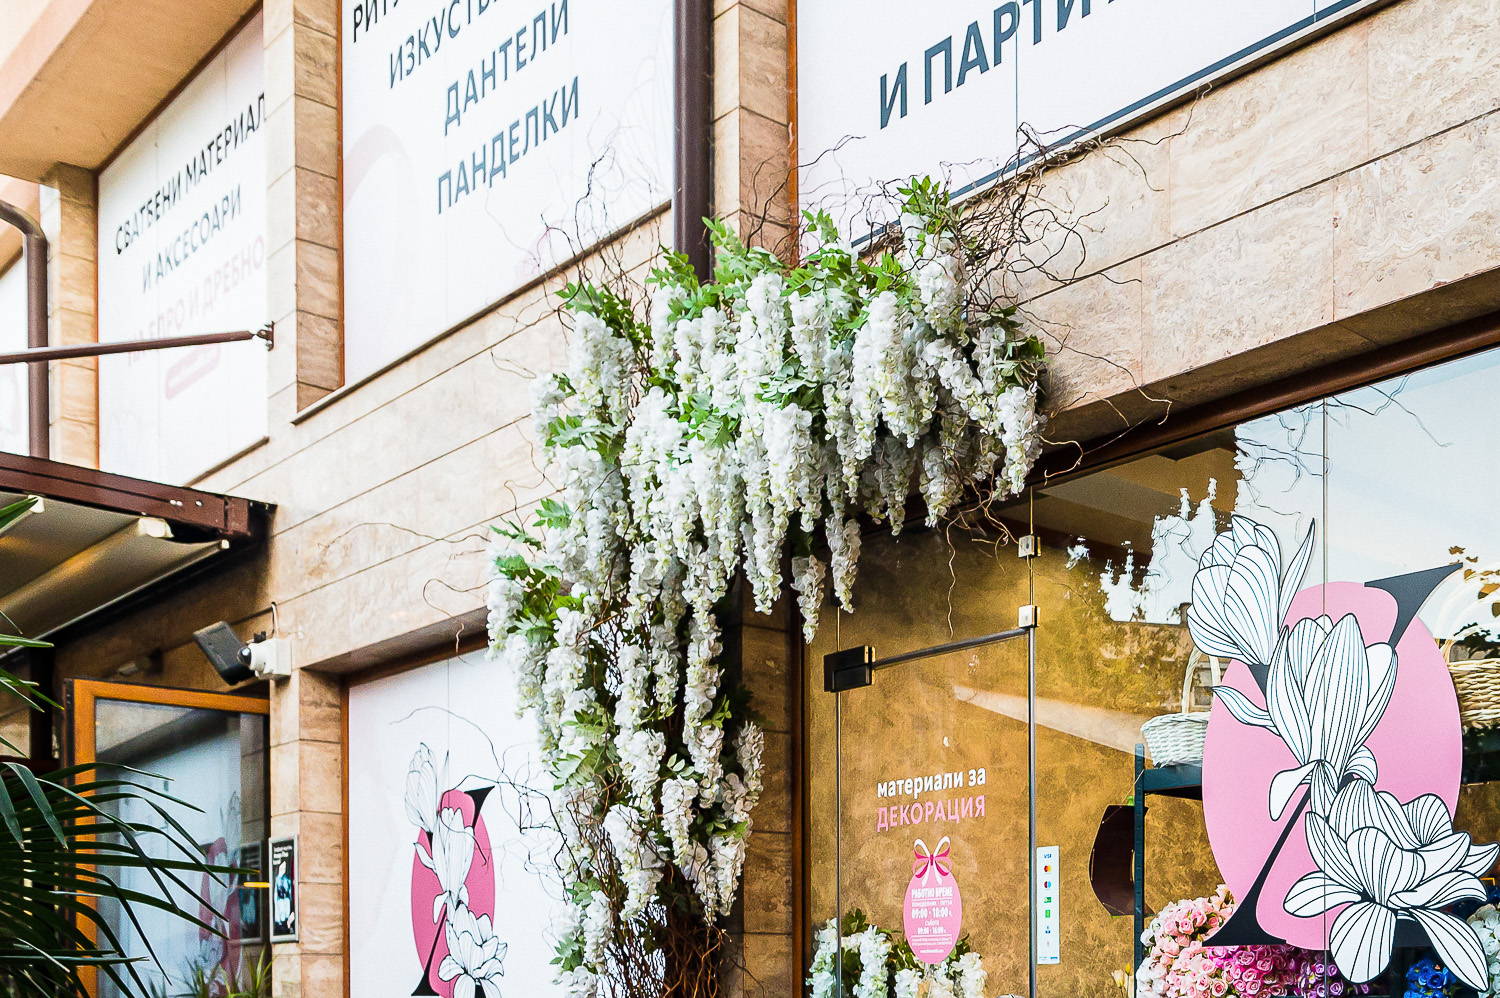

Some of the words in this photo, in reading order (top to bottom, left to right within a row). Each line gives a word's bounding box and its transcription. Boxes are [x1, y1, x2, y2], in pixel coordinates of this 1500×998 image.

[445, 0, 568, 136] ДАНТЕЛИ
[880, 61, 908, 130] И
[438, 75, 579, 215] ПАНДЕЛКИ
[115, 171, 181, 255] СВАТБЕНИ
[143, 261, 151, 294] И
[156, 184, 241, 284] АКСЕСОАРИ
[203, 235, 265, 316] ДРЕБНО
[877, 771, 964, 800] материали
[968, 767, 986, 787] за
[877, 795, 986, 833] ДЕКОРАЦИЯ
[911, 908, 928, 919] 09:00
[932, 907, 949, 918] 18:00
[912, 888, 935, 898] РАБОТНО
